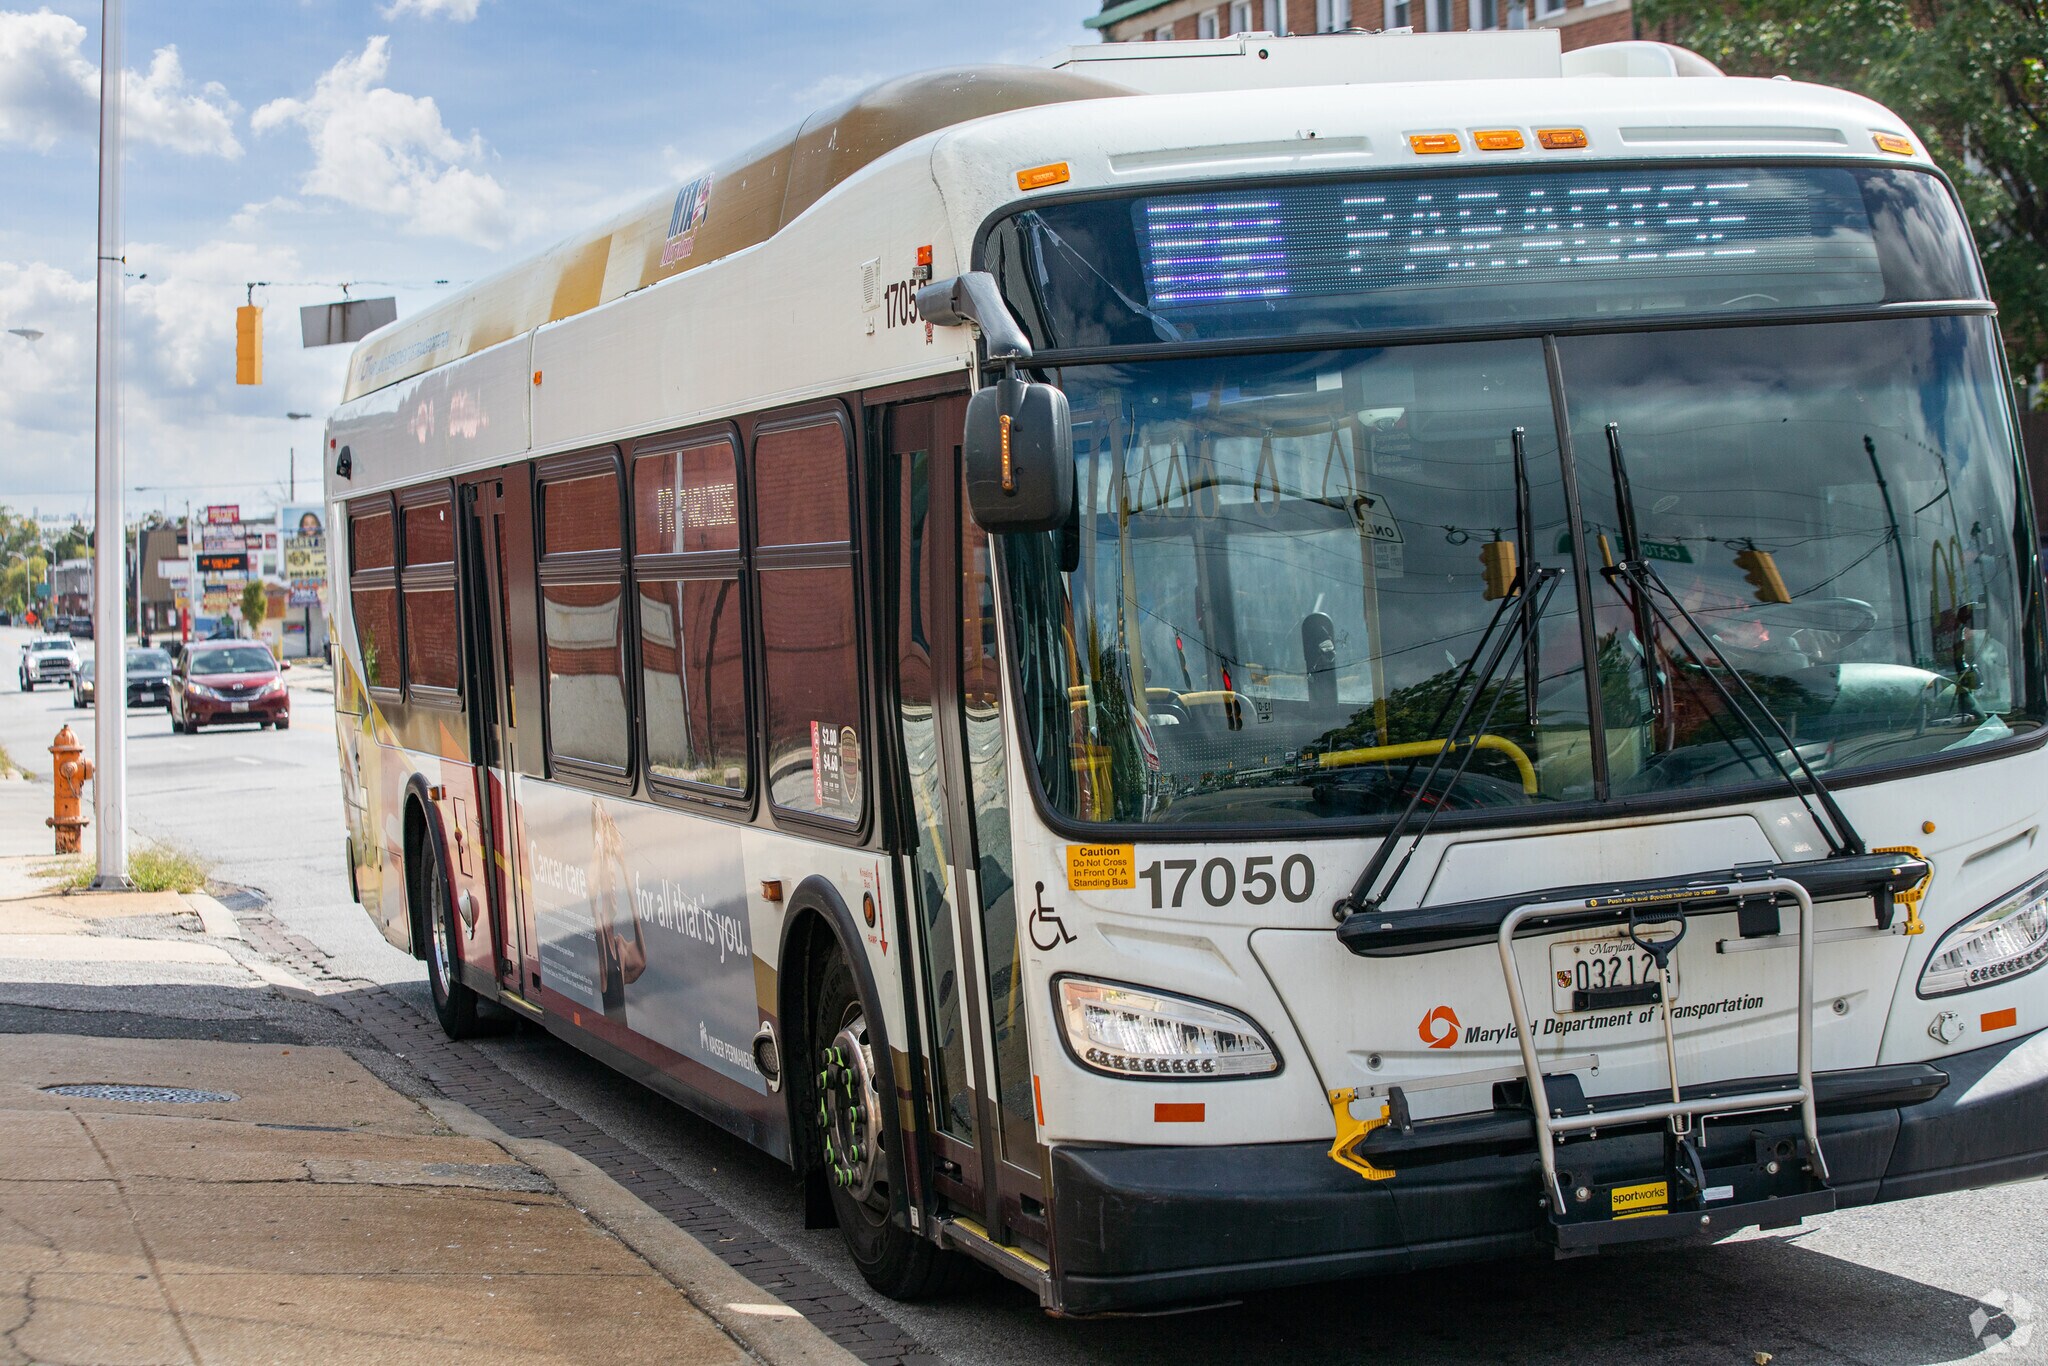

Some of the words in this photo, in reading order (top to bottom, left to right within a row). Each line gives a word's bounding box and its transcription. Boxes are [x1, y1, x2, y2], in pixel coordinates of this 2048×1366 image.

[1080, 847, 1120, 857] Caution
[531, 840, 564, 891] Cancer
[565, 864, 587, 899] care
[1073, 859, 1085, 867] Do
[1086, 858, 1101, 867] Not
[1103, 858, 1128, 867] Cross
[1074, 869, 1082, 877] In
[1083, 868, 1105, 877] Front
[1107, 867, 1118, 876] Of
[1120, 867, 1127, 876] A
[1073, 878, 1111, 888] Standing
[1112, 877, 1129, 886] Bus
[1139, 853, 1316, 910] 17050
[636, 870, 654, 923] for
[674, 884, 702, 941] that
[701, 893, 715, 945] is
[716, 912, 748, 964] you.
[1465, 1020, 1538, 1044] Marylad
[1543, 1014, 1632, 1037] Department
[1639, 1007, 1655, 1024] of
[1613, 1187, 1665, 1205] sportworks
